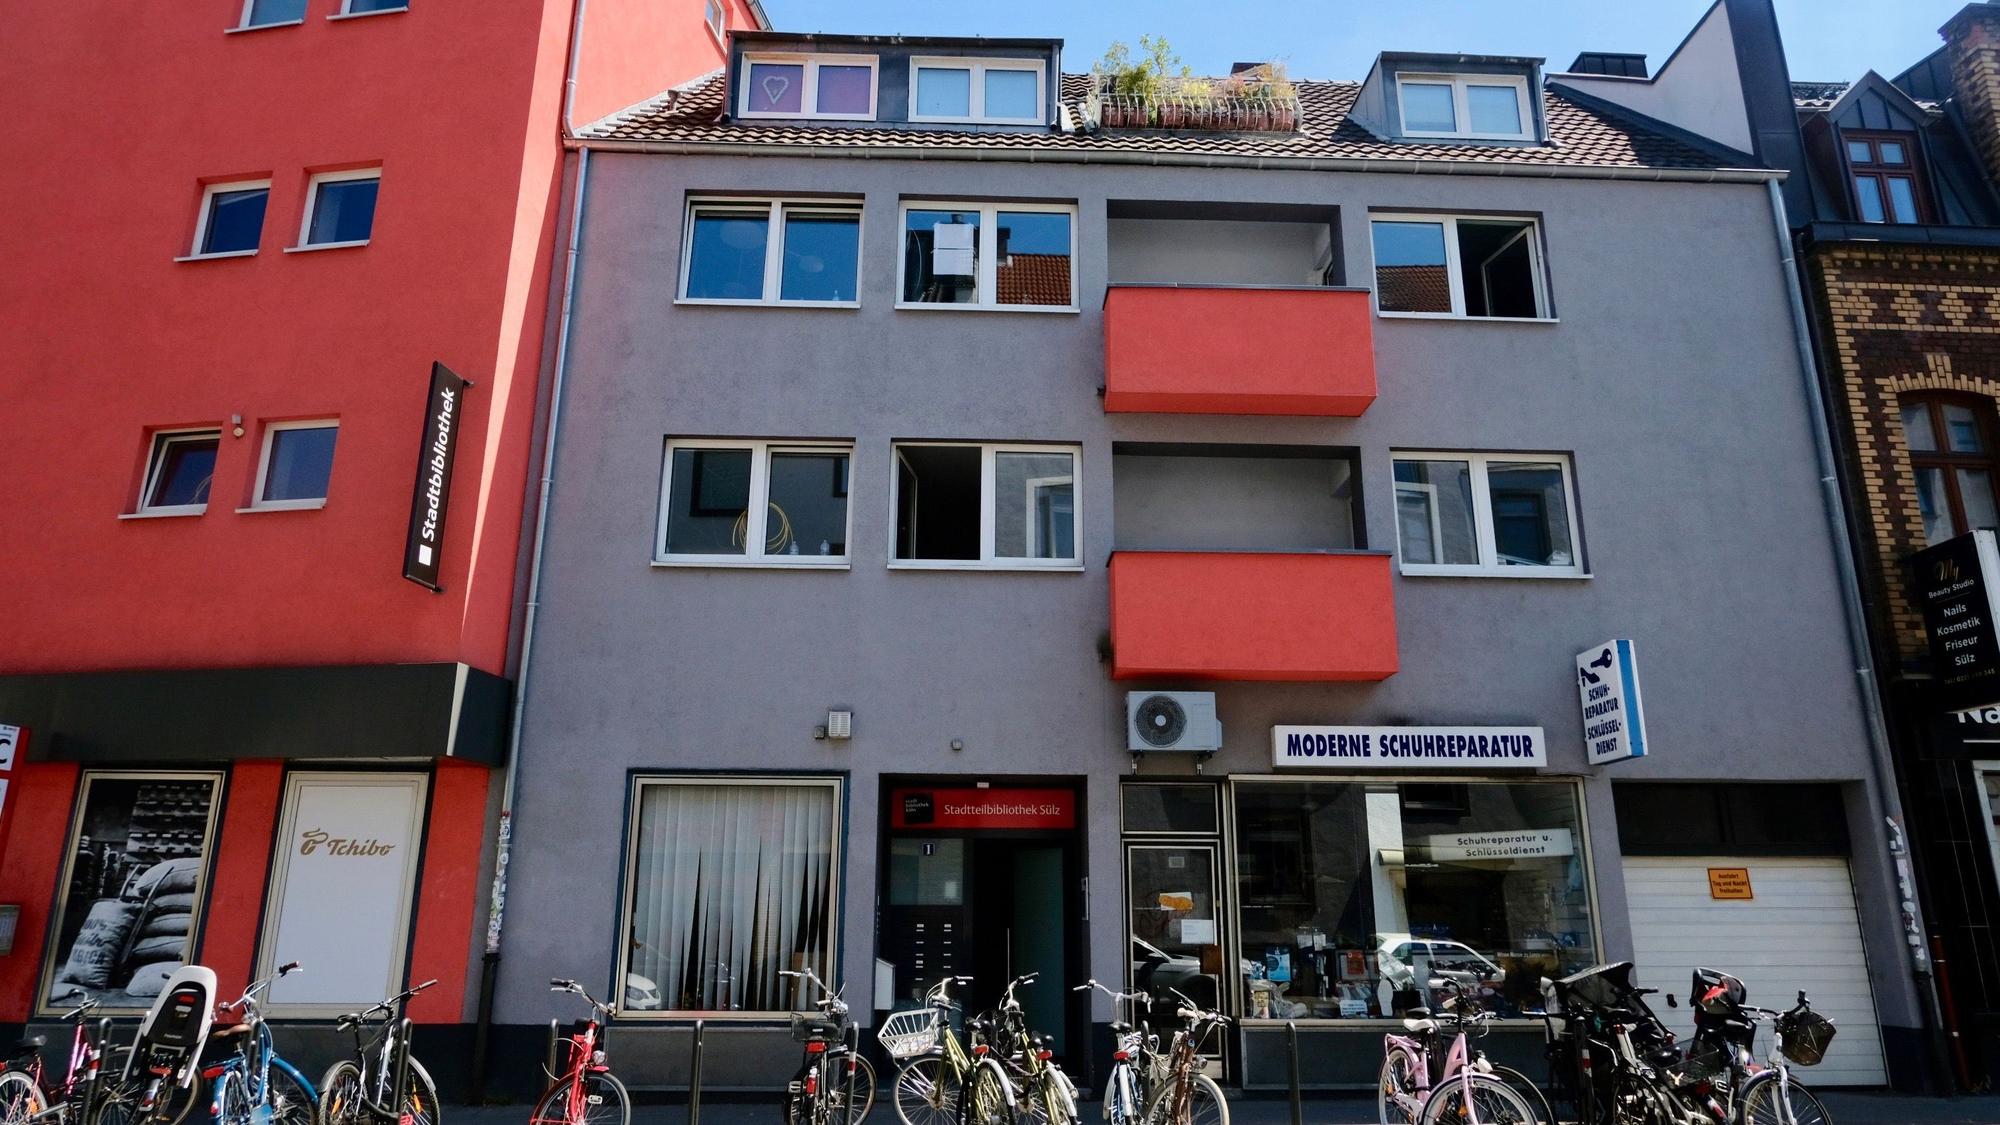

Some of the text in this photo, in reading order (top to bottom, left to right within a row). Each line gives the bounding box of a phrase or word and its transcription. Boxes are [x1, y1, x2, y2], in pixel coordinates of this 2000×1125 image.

[422, 387, 455, 542] Stadtbibliothek
[1928, 579, 1975, 598] Beauty Studio
[1943, 603, 1967, 618] Nails
[1936, 617, 1981, 637] Kosmetik
[1945, 635, 1978, 651] Friseur
[1954, 653, 1976, 666] Sülz
[1585, 698, 1619, 719] REPARATUR
[1287, 733, 1534, 758] MODERNE SCHUHREPARATUR
[1596, 737, 1617, 755] DIENST
[944, 804, 1060, 815] Stadtteilbibliothek Sülz
[327, 839, 396, 856] Tchibo
[1457, 835, 1537, 846] Schuhreparatur
[925, 844, 932, 855] 1
[1466, 846, 1545, 857] Schlüsseldienst
